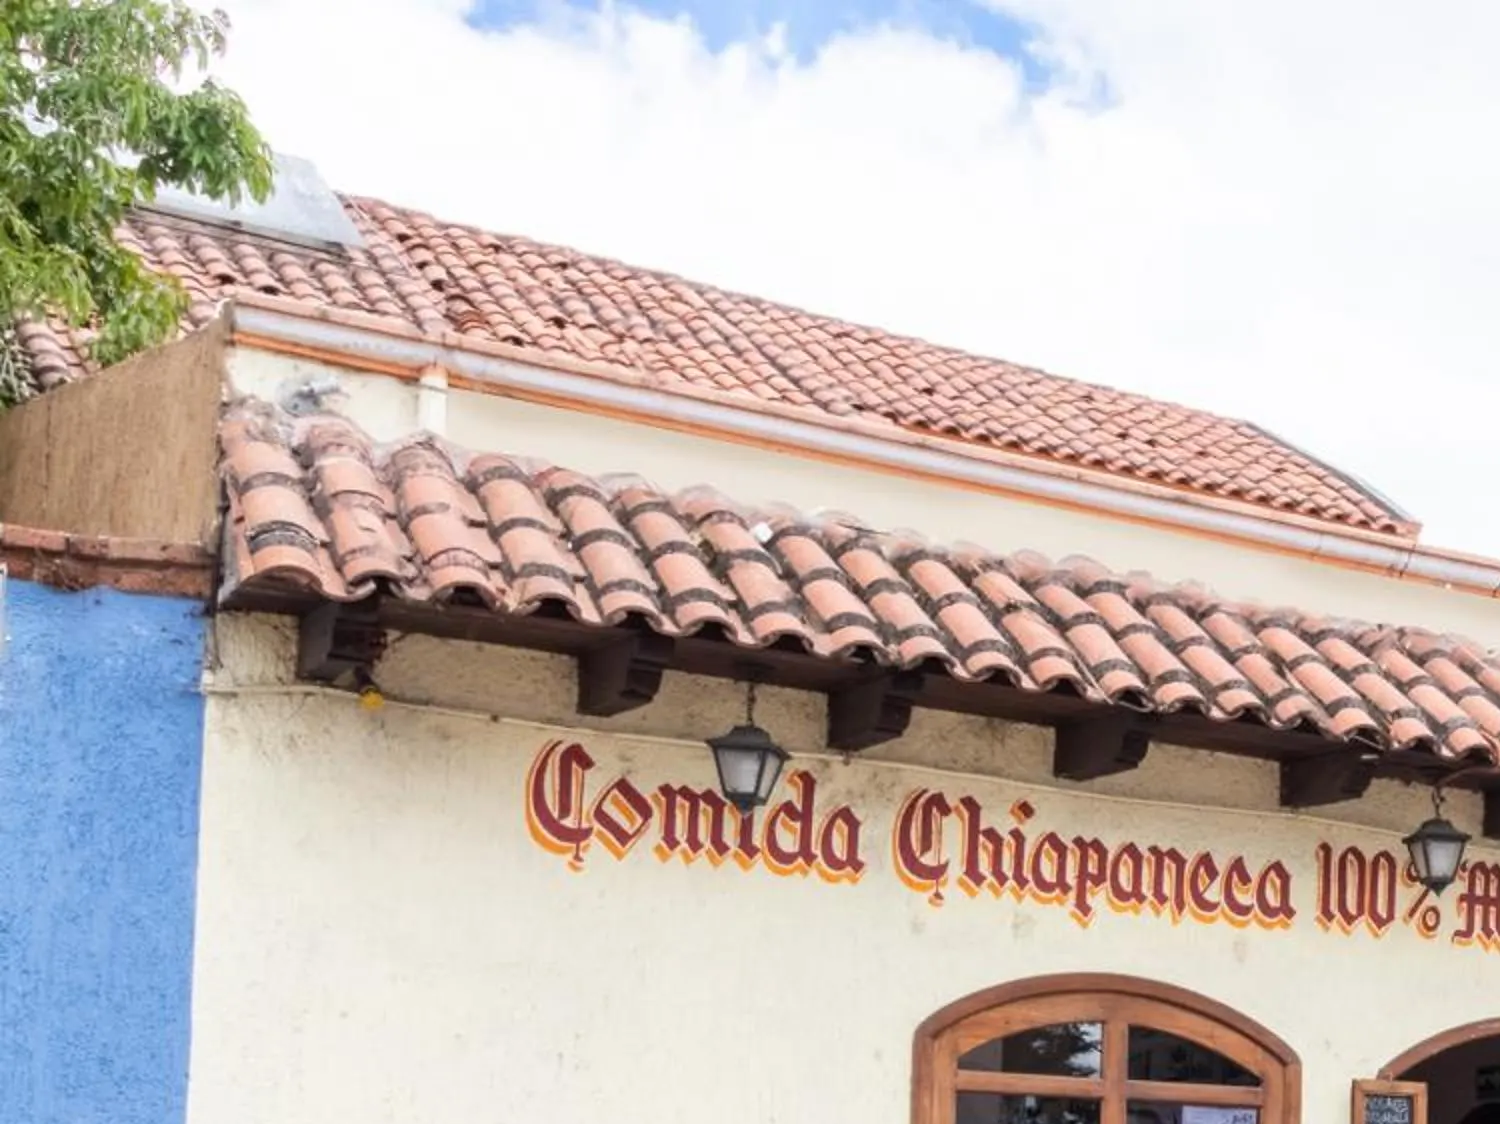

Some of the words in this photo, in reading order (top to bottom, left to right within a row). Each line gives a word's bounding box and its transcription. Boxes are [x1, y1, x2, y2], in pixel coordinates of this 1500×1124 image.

[525, 739, 867, 885] Comida
[892, 787, 1297, 930] Chiapaneca
[1313, 841, 1441, 938] 100%
